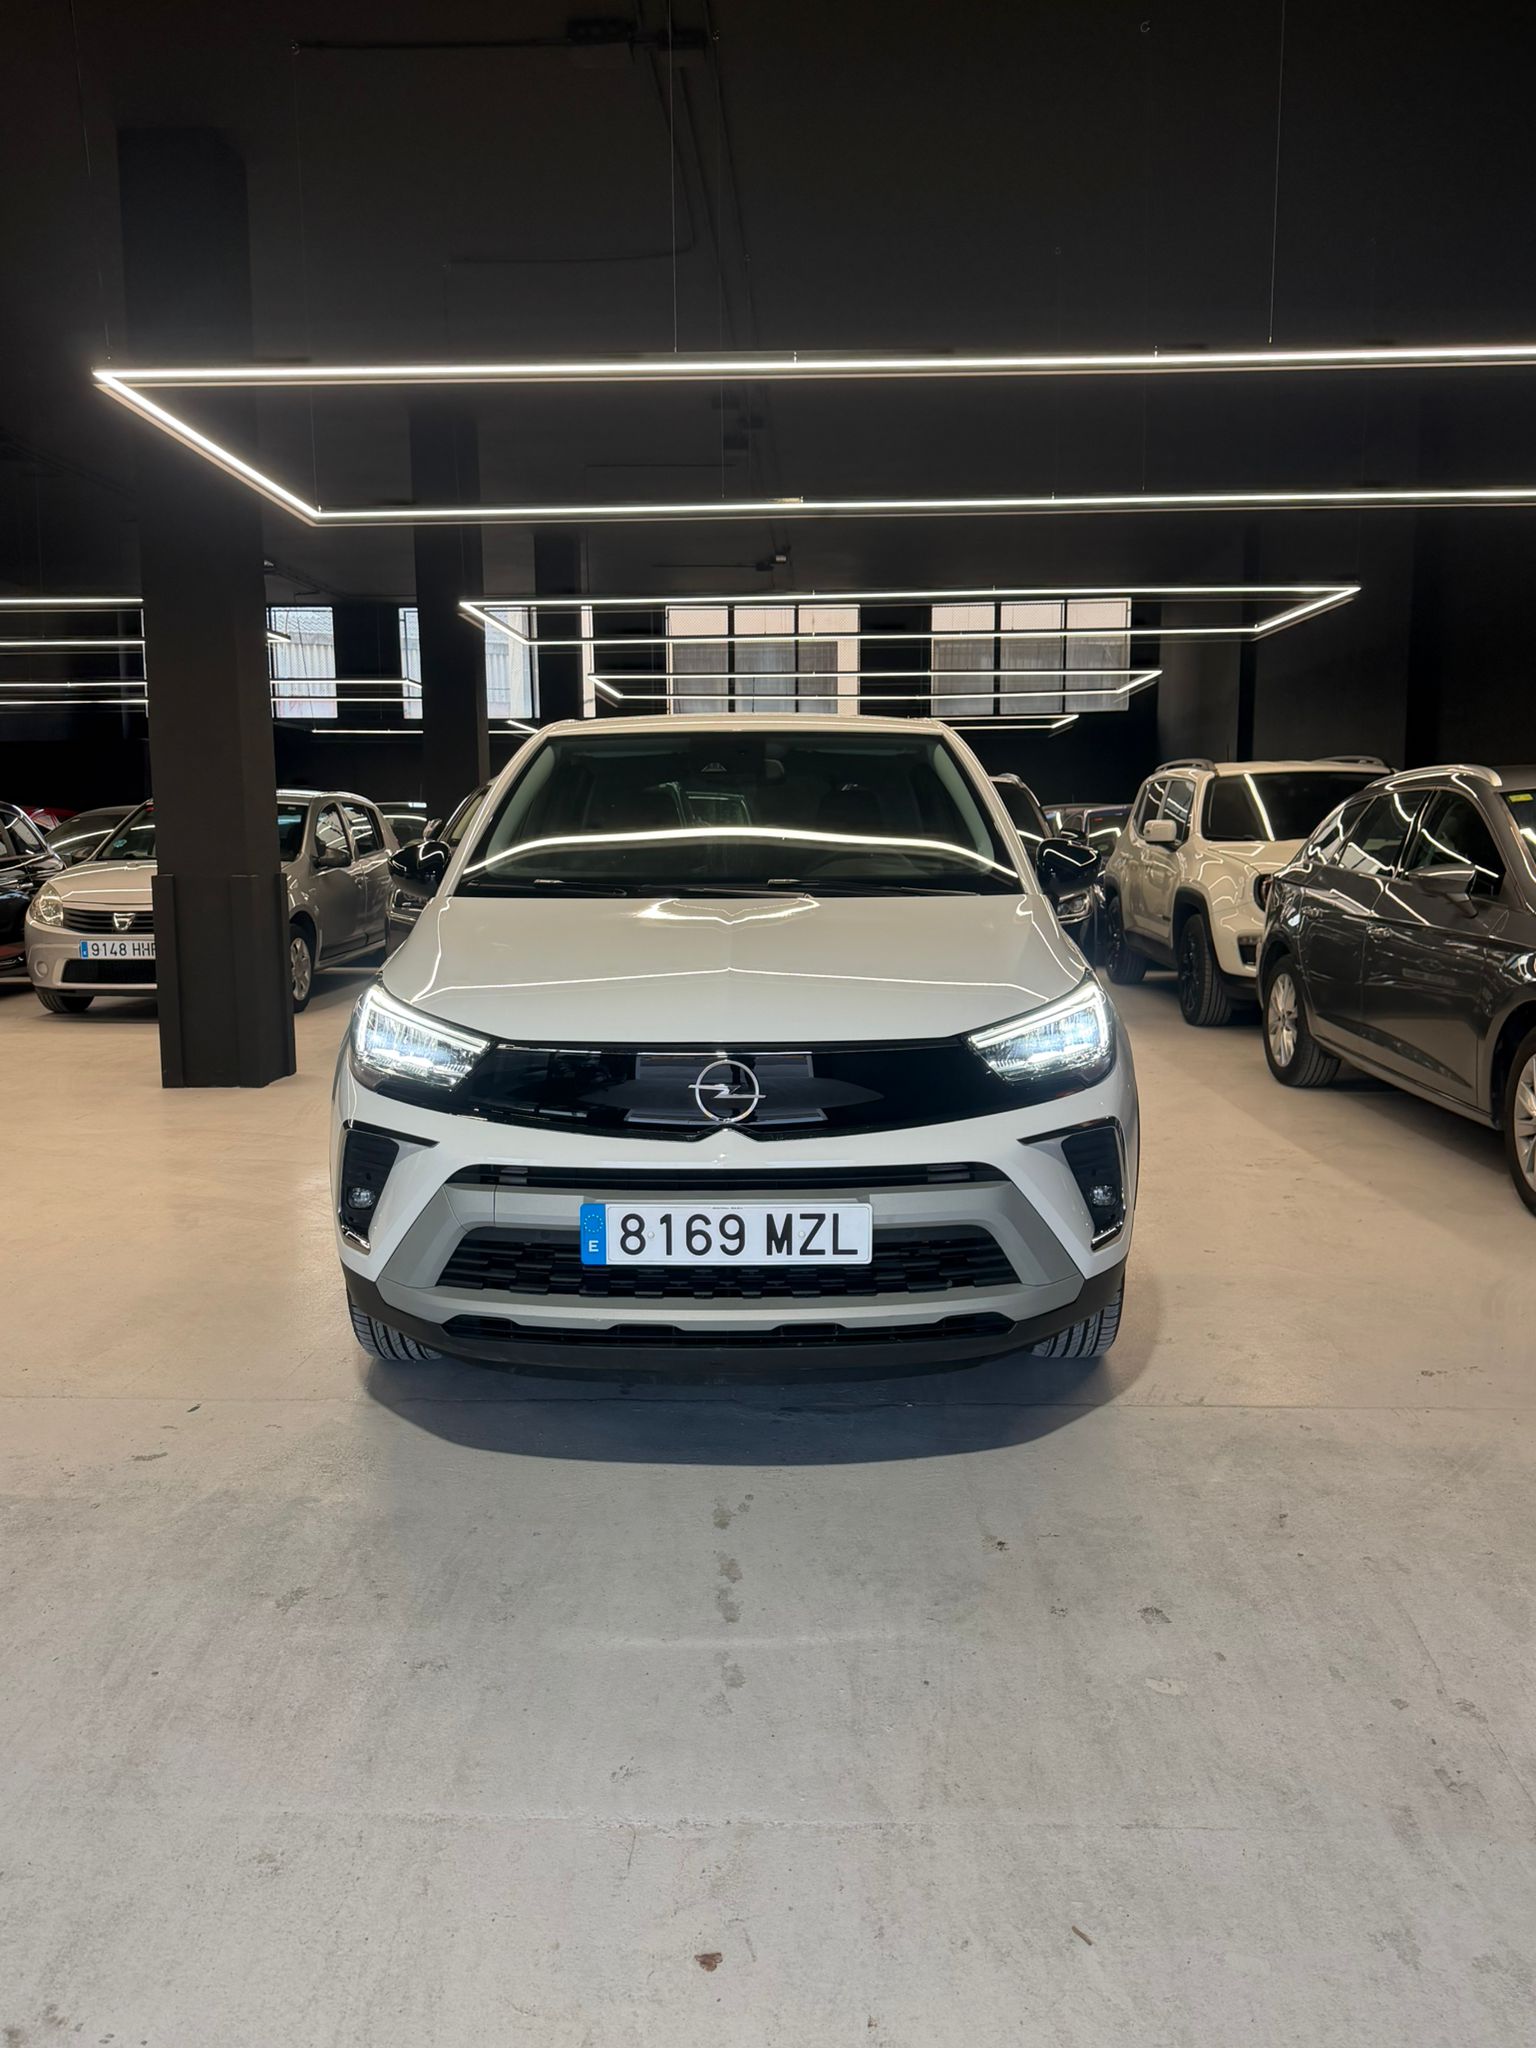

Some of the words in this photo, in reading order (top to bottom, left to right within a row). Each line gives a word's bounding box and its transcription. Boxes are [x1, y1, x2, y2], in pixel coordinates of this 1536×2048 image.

[91, 943, 127, 956] 9148
[619, 1213, 745, 1256] 8169
[766, 1213, 858, 1256] MZL
[588, 1240, 600, 1252] E
